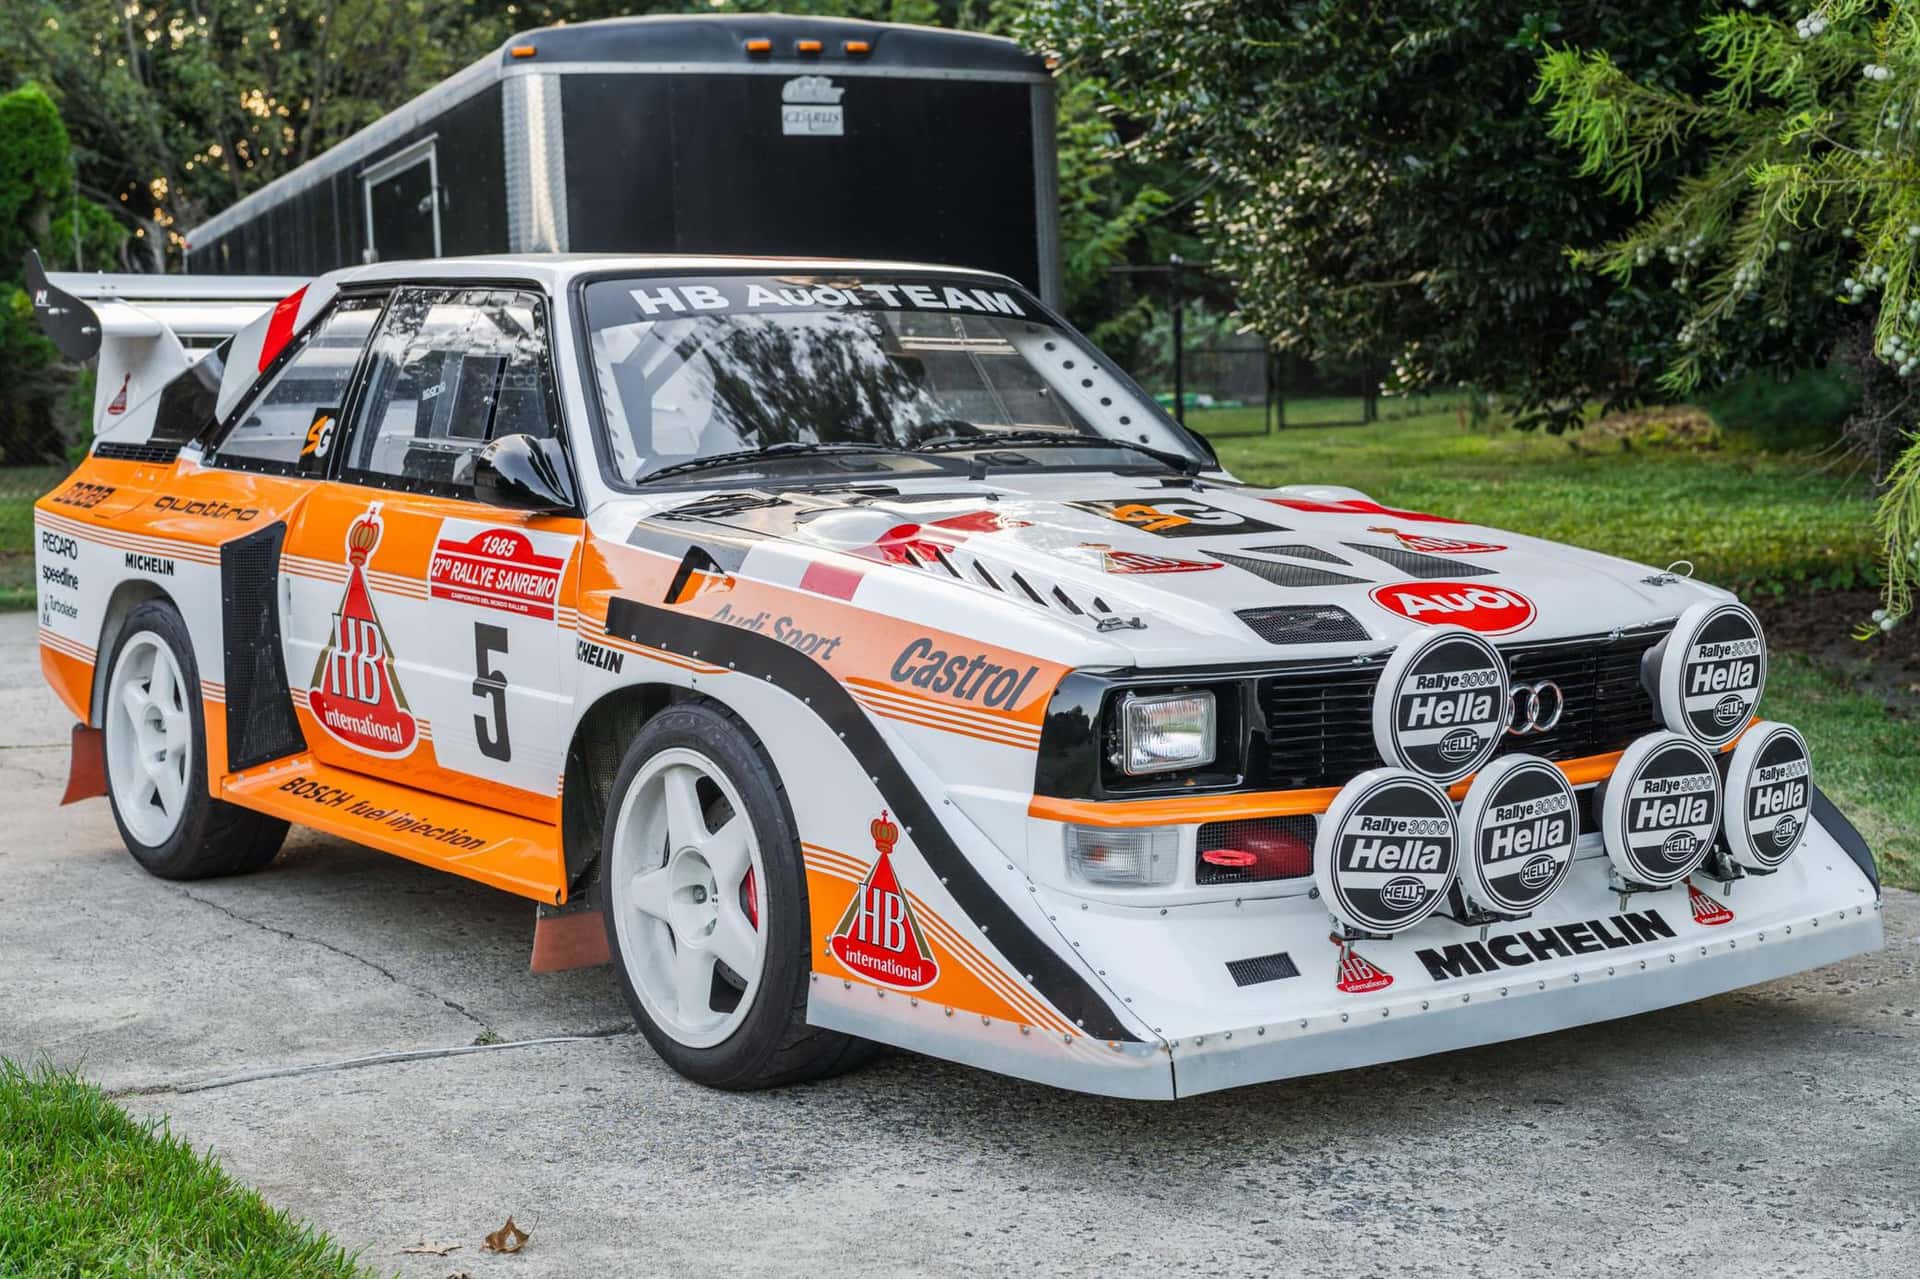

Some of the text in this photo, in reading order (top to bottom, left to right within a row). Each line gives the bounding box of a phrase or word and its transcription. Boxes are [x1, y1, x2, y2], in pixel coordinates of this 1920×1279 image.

[629, 285, 729, 315] HB
[860, 284, 1026, 317] TEAM
[154, 496, 260, 522] quattro
[42, 531, 78, 560] RECARO
[481, 535, 518, 557] 1985
[125, 552, 175, 577] MICHELIN
[450, 560, 497, 588] RALLYE
[496, 568, 556, 599] SANREMO
[332, 613, 385, 706] HB
[1698, 639, 1758, 660] Rallye 3000
[889, 637, 1040, 712] Castrol
[1416, 670, 1497, 690] Rallye 3000
[1691, 660, 1754, 694] Hella
[471, 621, 512, 763] 5
[1407, 694, 1492, 727] Hella
[1715, 699, 1744, 717] HELLA
[323, 702, 404, 745] international
[1440, 734, 1480, 752] HELLA
[1643, 774, 1713, 793] Rallye 3000
[1759, 765, 1786, 782] Rallye
[279, 776, 487, 850] BOSCH fuel injection
[1495, 795, 1568, 823] Rallye 3000
[1754, 782, 1804, 817] Hella
[1360, 816, 1448, 835] Rallye 3000
[1636, 798, 1709, 830] Hella
[1489, 819, 1565, 860] Hella
[1775, 820, 1799, 837] HELLA
[1348, 839, 1442, 870] Hella
[1664, 836, 1697, 854] HELLA
[1521, 859, 1556, 881] HELLA
[1382, 883, 1426, 902] HELLA
[1689, 895, 1720, 916] HB
[858, 882, 907, 953] HB
[1414, 909, 1678, 981] MICHELIN
[845, 944, 922, 983] international
[1337, 958, 1374, 982] HB
